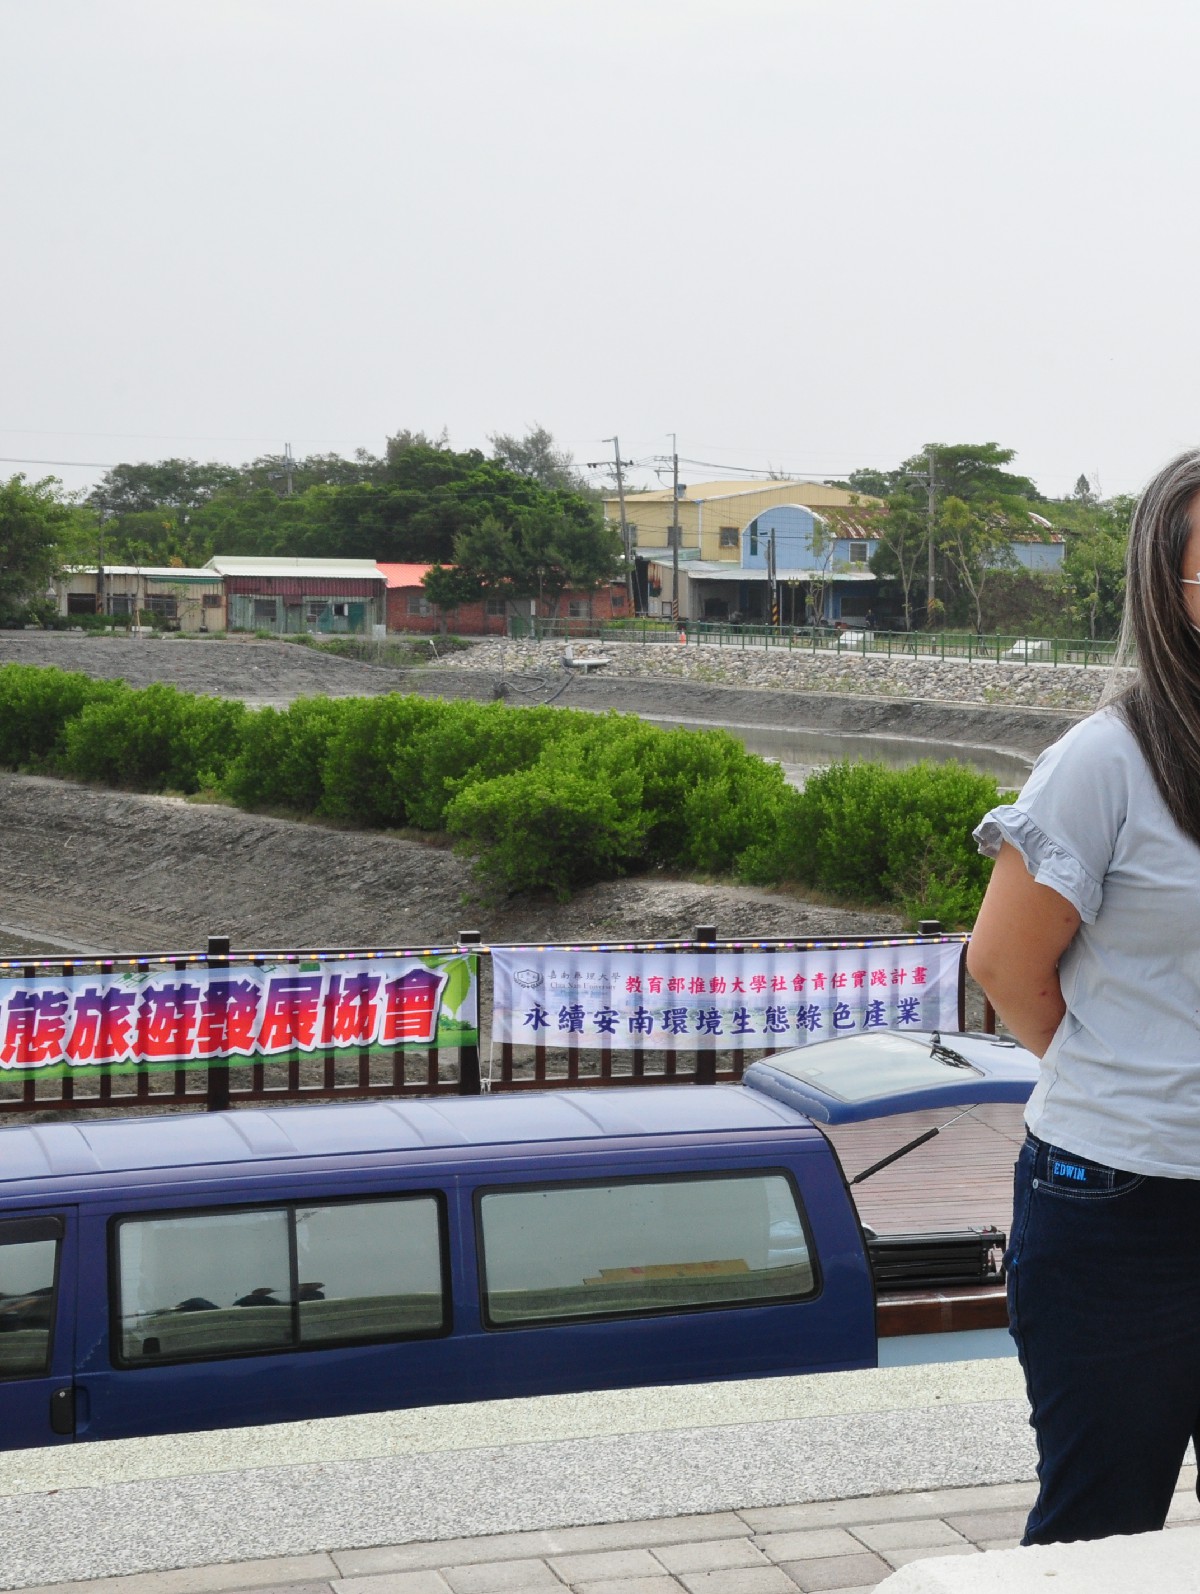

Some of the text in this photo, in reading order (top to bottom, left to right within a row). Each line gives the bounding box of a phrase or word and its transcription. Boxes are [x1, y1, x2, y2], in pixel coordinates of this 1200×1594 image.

[625, 967, 928, 995] 教育部推動大學社會責任實踐計畫
[0, 968, 443, 1064] 態旅遊發展協會
[523, 997, 922, 1036] 永續安南環境生態綠色產業
